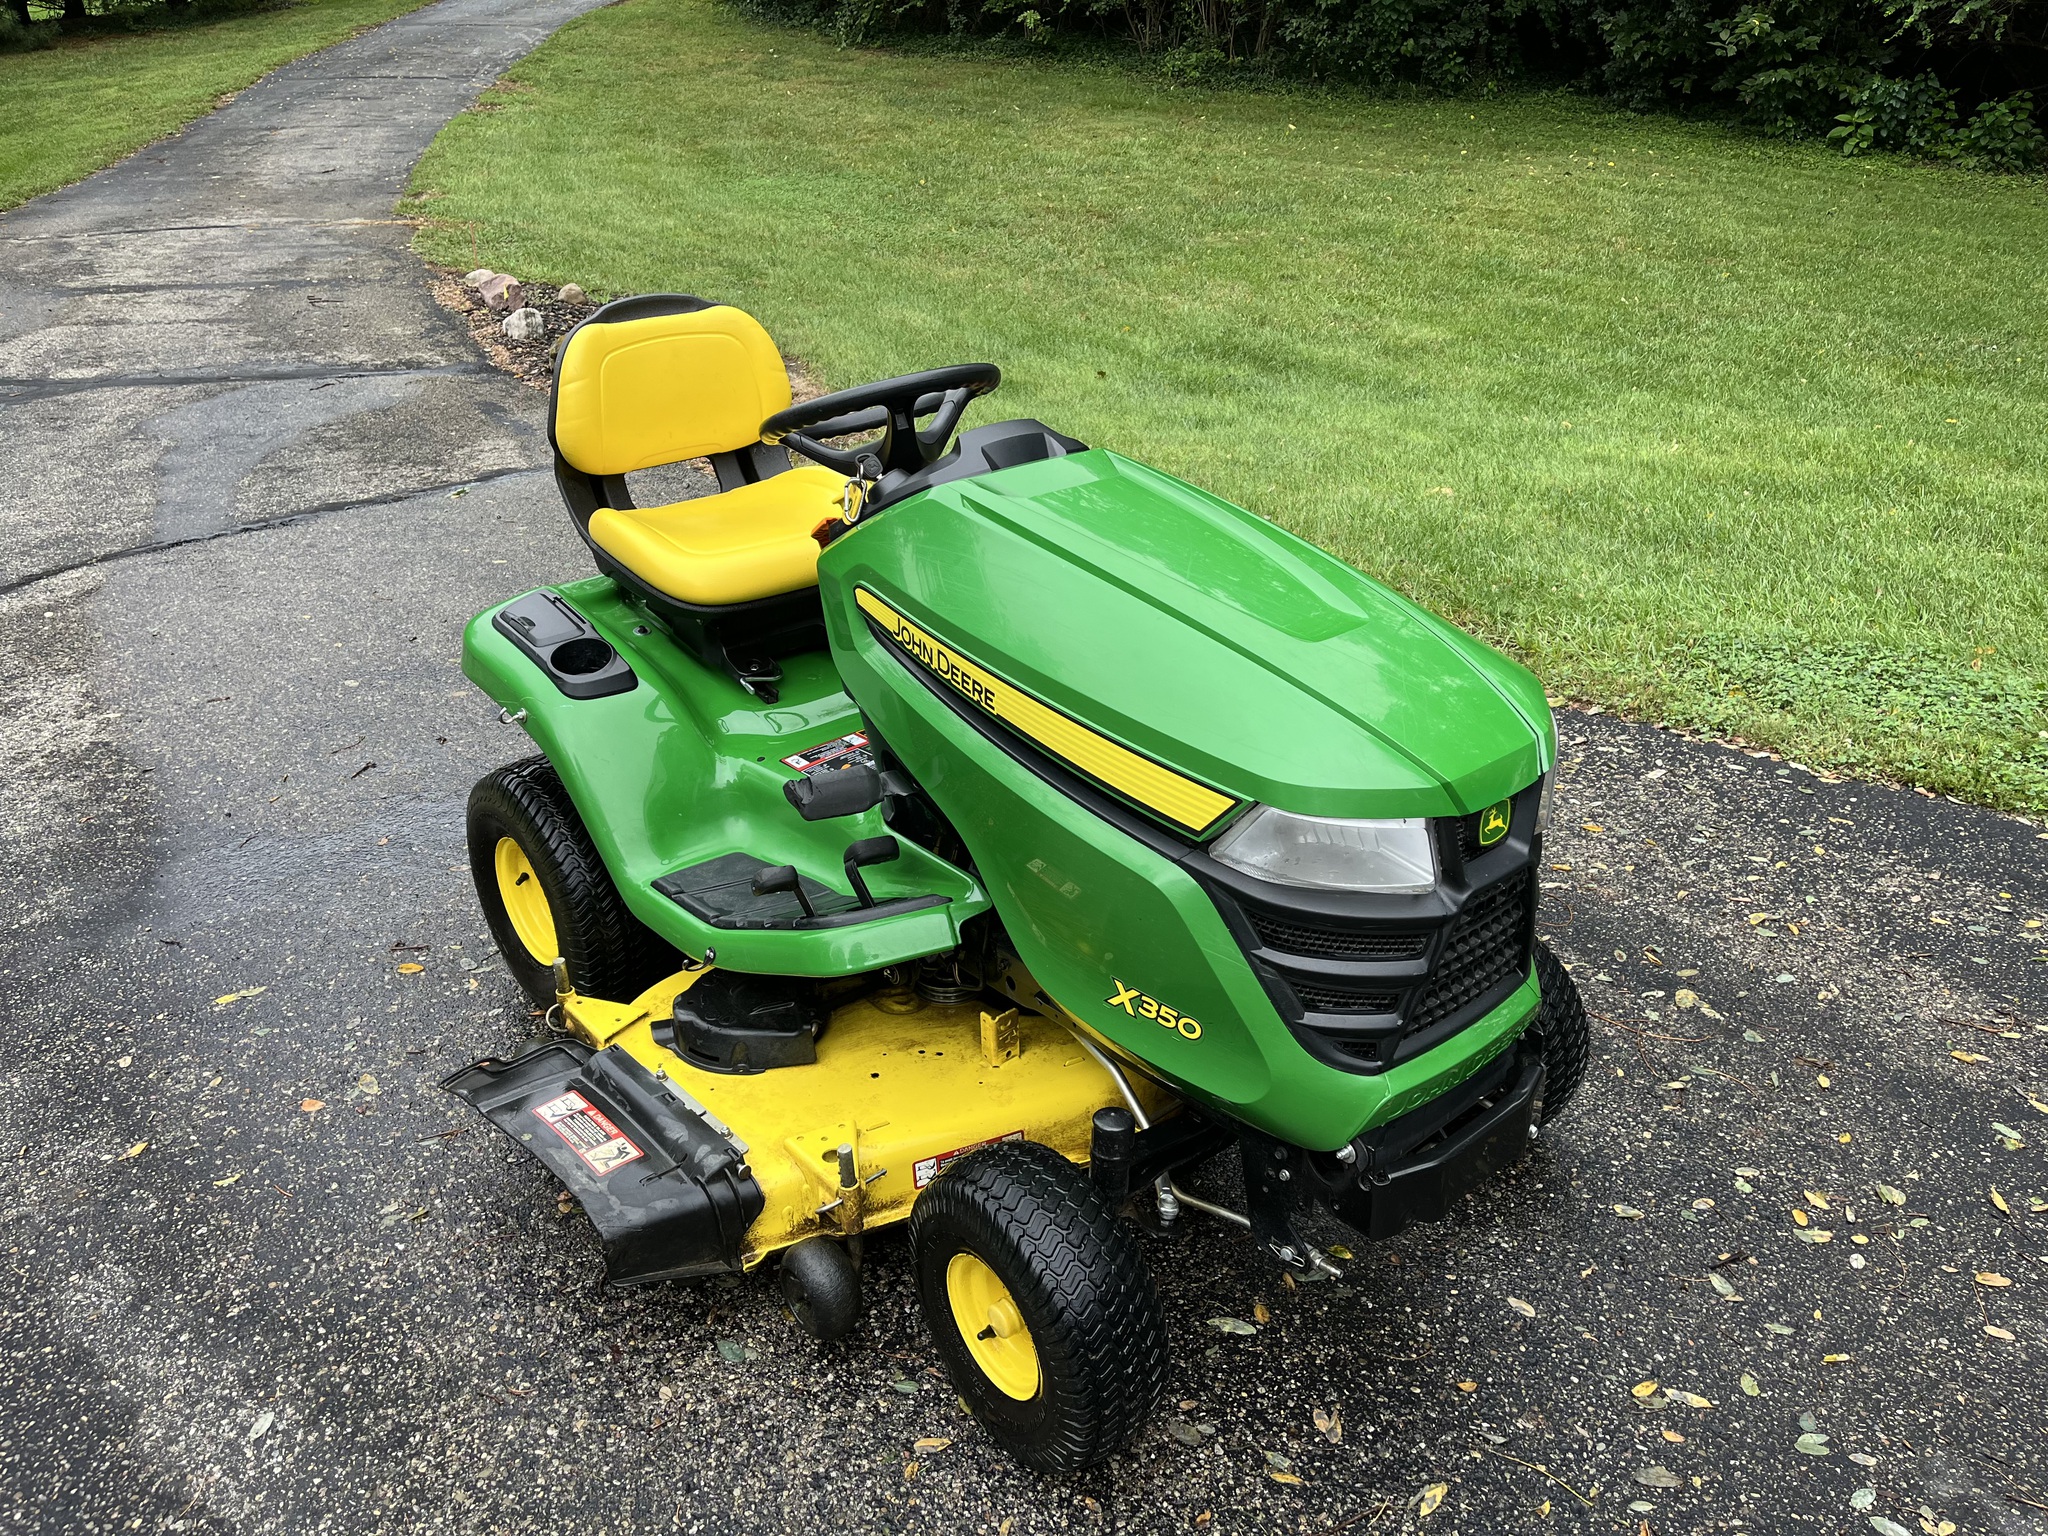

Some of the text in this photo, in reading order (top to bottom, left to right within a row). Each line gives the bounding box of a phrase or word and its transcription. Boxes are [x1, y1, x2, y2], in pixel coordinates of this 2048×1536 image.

[893, 617, 996, 712] JOHN DEERE
[1104, 977, 1203, 1040] X350
[592, 1113, 619, 1136] DANGER
